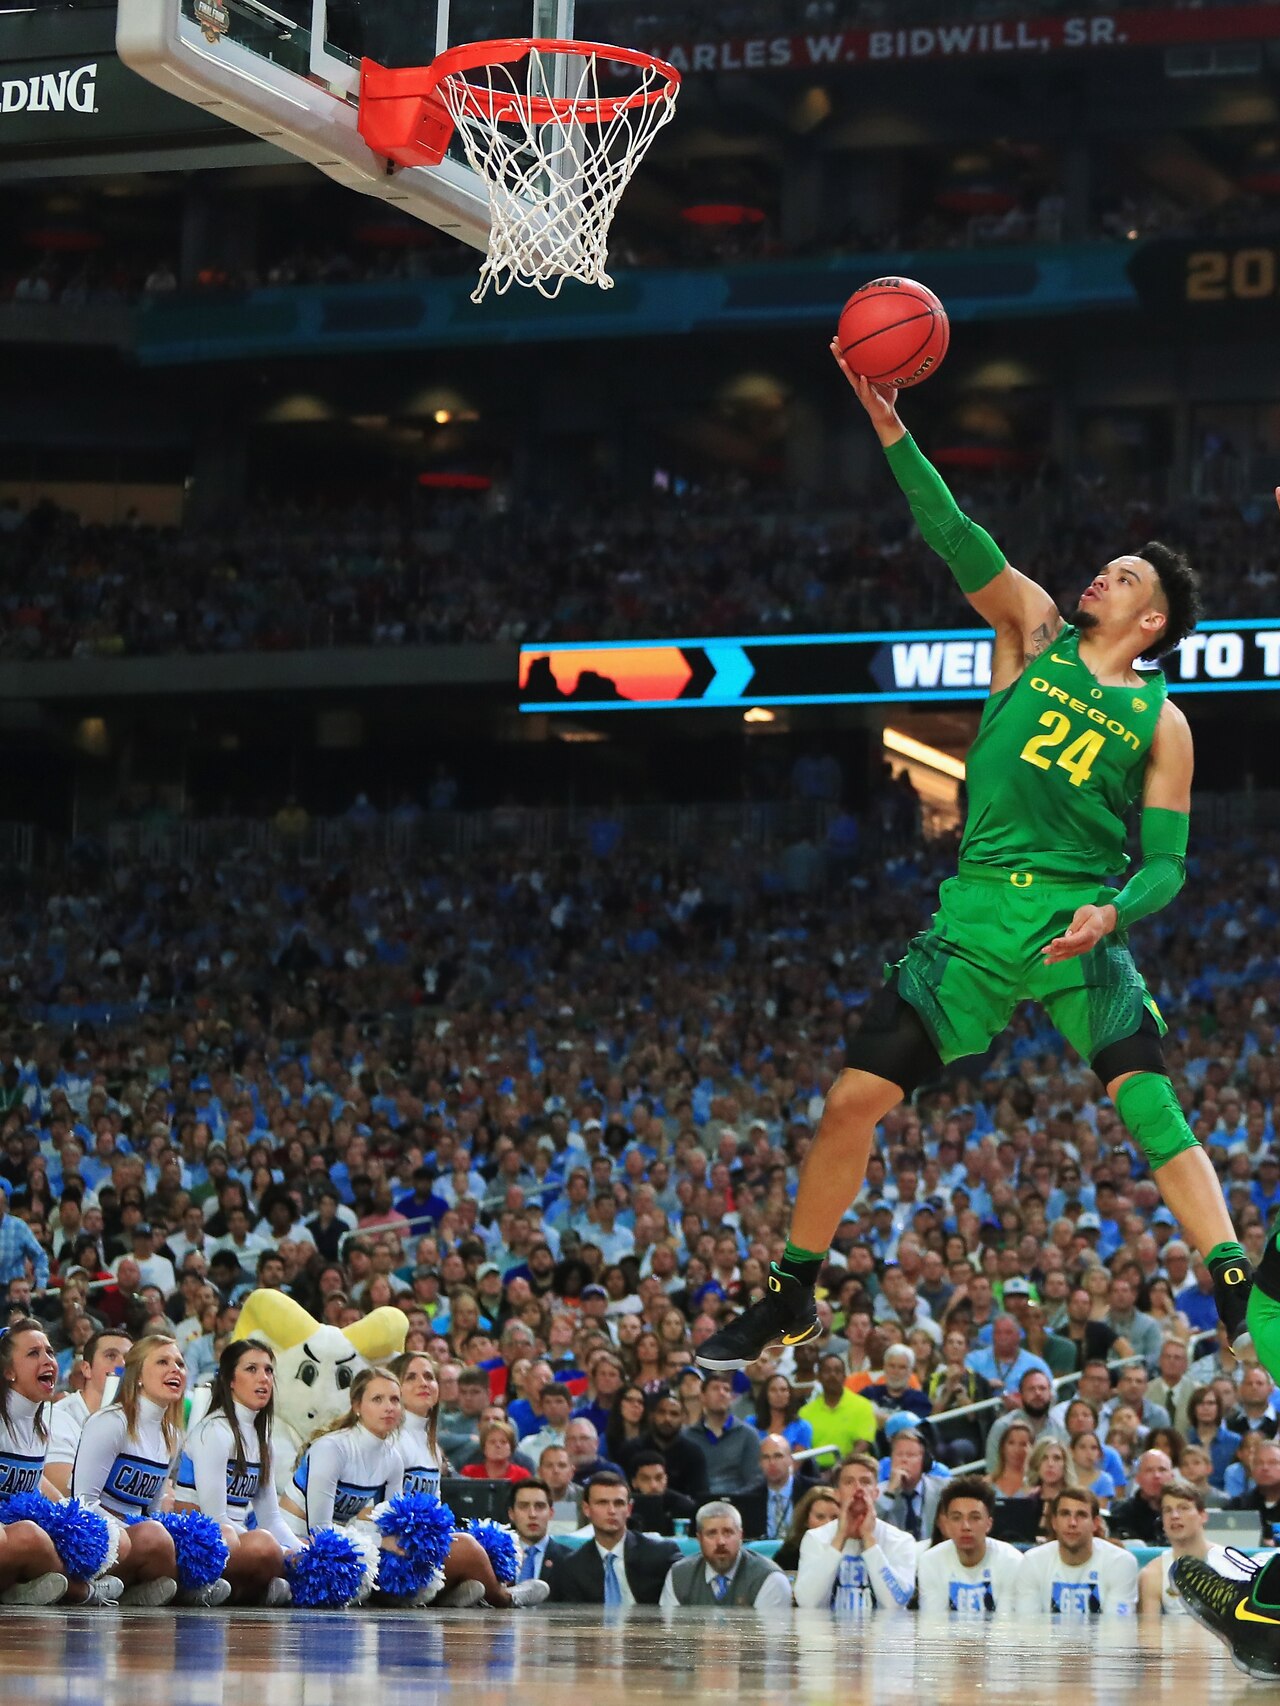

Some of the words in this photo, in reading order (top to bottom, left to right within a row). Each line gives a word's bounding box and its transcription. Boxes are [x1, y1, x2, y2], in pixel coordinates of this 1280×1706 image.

[608, 37, 791, 77] CARLES
[806, 35, 855, 63] W.
[868, 22, 1050, 59] BIDWILL,
[1063, 16, 1127, 46] SR.
[0, 64, 97, 113] DING
[892, 640, 992, 688] WEL
[1176, 632, 1243, 679] TO
[1030, 677, 1141, 750] OREGON
[1020, 710, 1106, 787] 24
